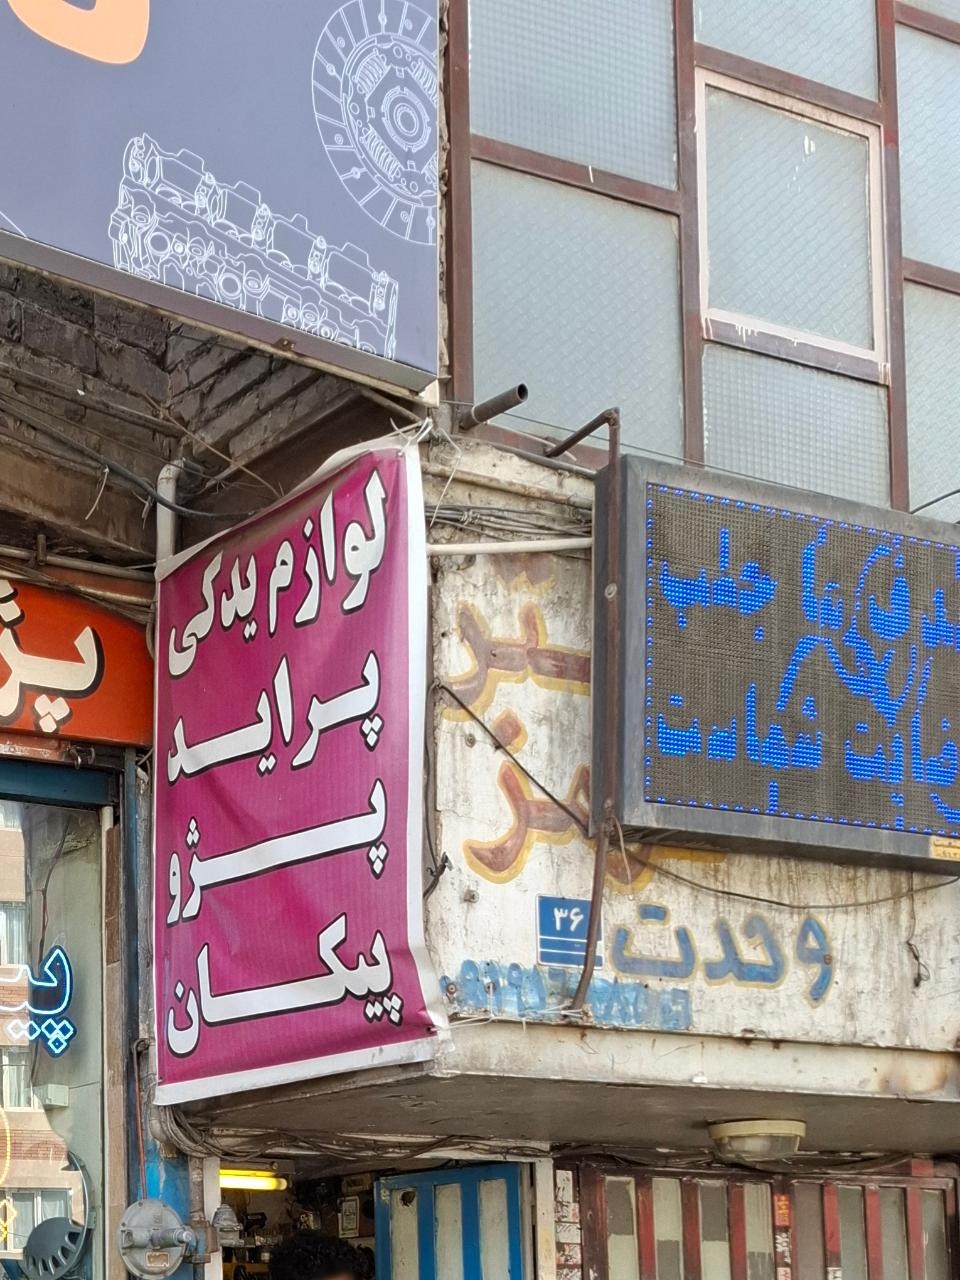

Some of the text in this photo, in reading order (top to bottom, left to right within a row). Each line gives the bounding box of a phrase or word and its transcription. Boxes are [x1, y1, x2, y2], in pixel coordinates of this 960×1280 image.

[167, 551, 259, 678] یدکی
[268, 468, 388, 637] لوازم
[167, 650, 383, 784] پراید
[166, 778, 388, 926] پژو
[553, 906, 584, 932] ۳۶
[166, 912, 404, 1058] پیکان
[612, 904, 835, 1007] وحدت
